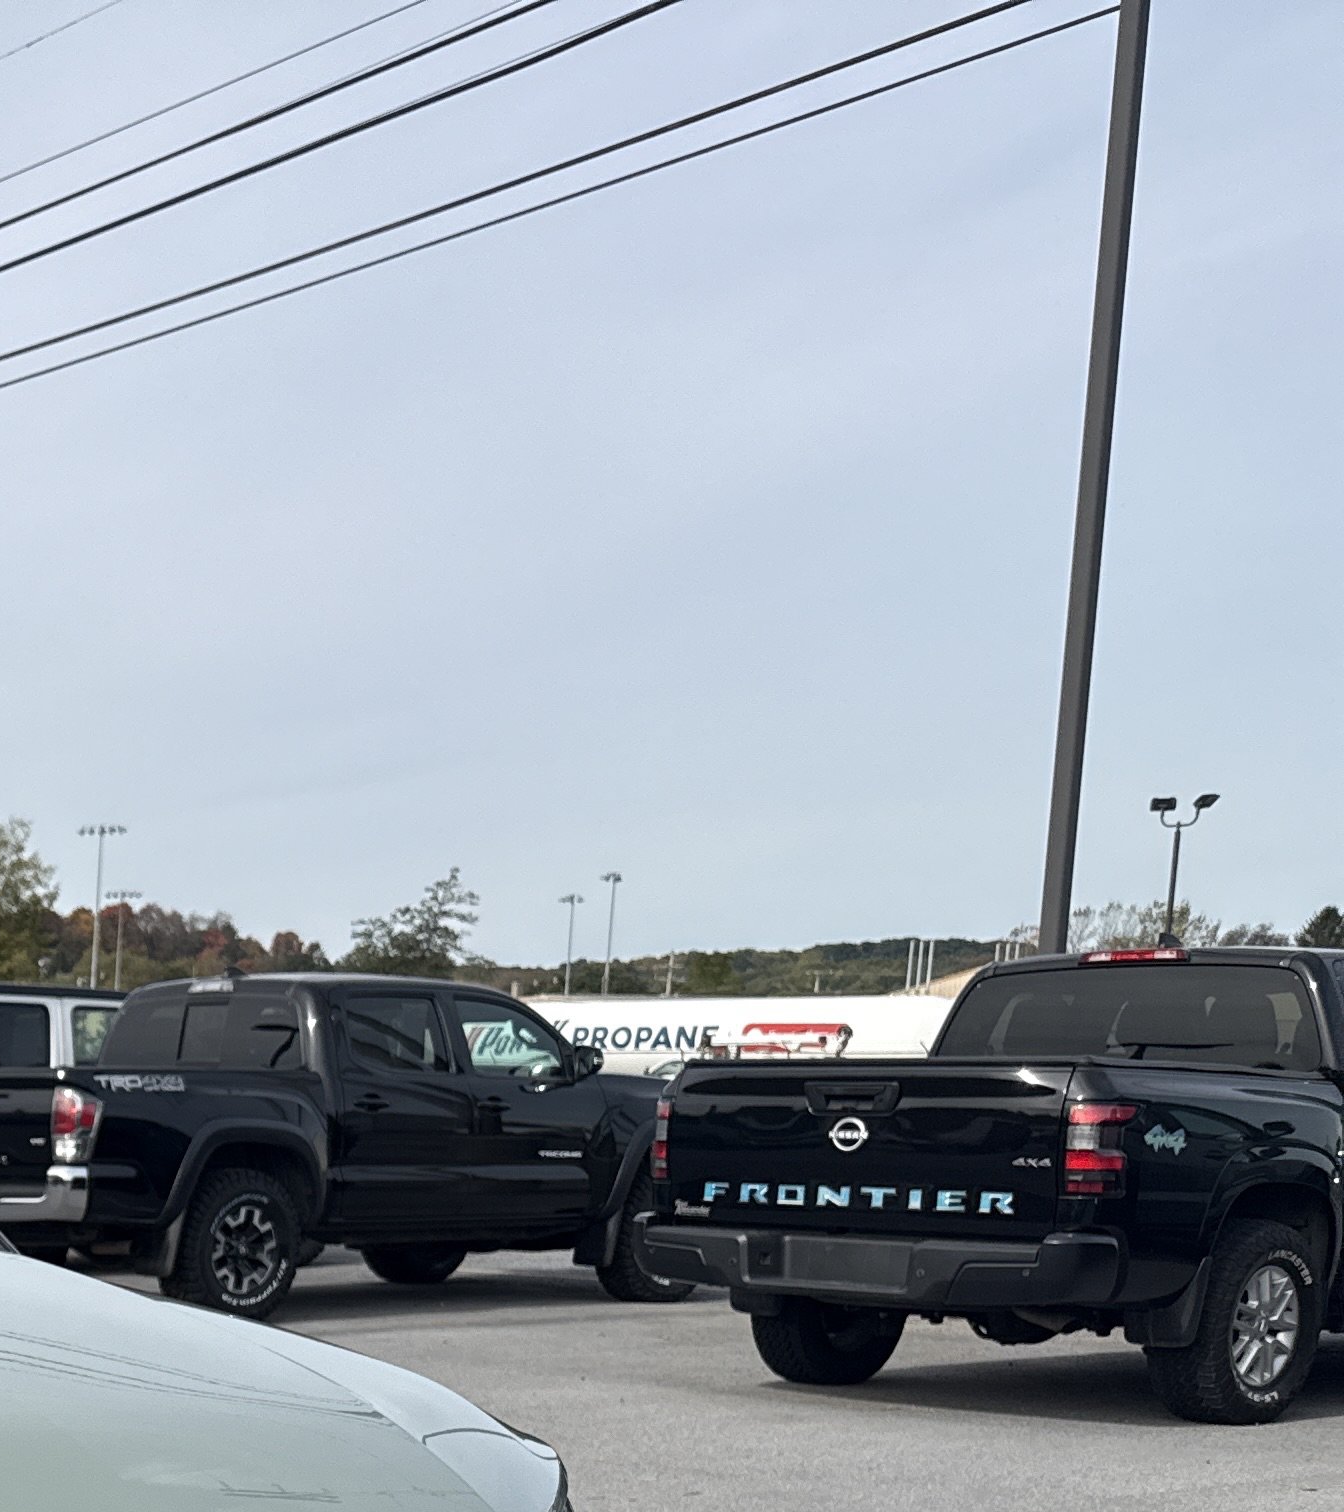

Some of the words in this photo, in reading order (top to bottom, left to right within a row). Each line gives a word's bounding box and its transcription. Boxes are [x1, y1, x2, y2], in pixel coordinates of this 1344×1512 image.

[93, 1074, 142, 1092] TRD
[703, 1181, 1015, 1214] FRONTIER
[1267, 1250, 1312, 1285] LANCASTER
